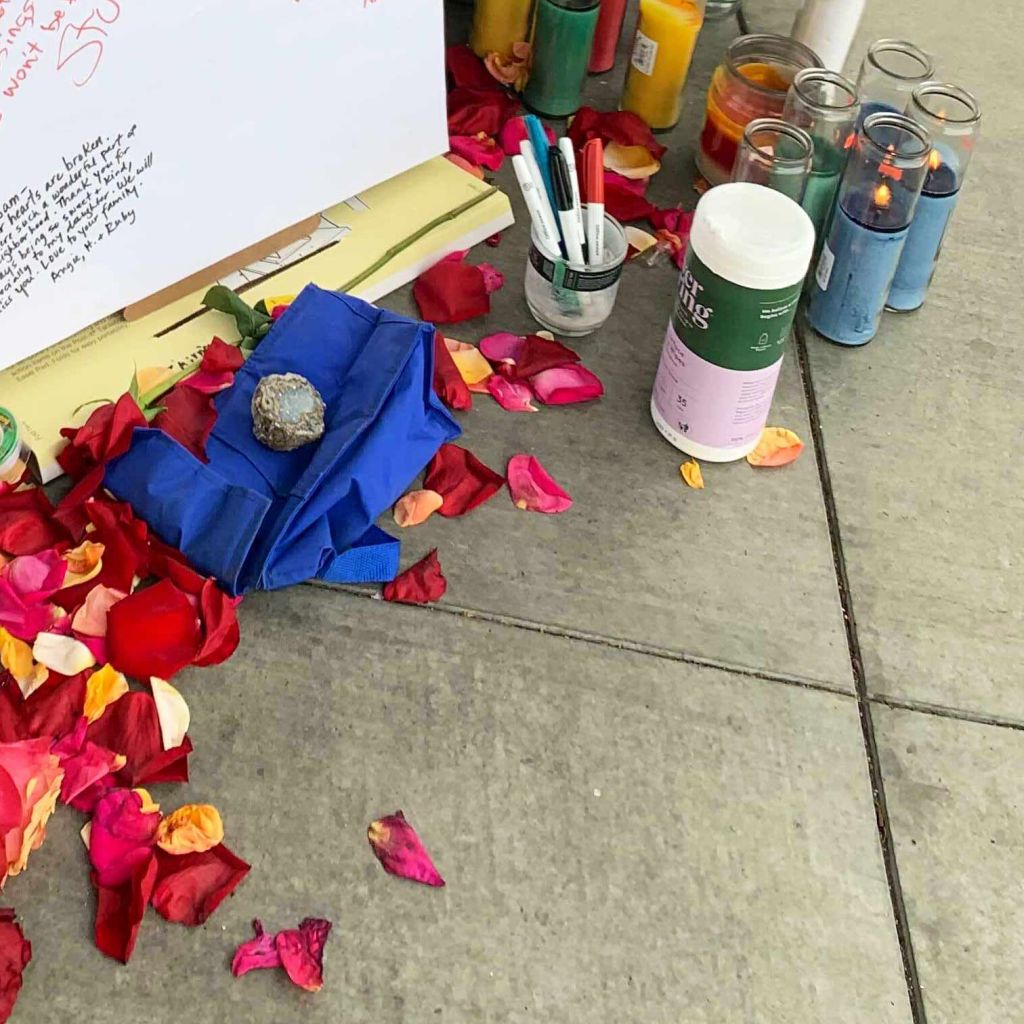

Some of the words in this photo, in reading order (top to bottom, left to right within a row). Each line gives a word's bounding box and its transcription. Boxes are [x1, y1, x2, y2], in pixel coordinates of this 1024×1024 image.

[7, 189, 42, 227] hearts
[44, 174, 64, 193] are
[15, 210, 41, 234] such
[51, 157, 97, 203] wonderful
[55, 178, 92, 211] Thank
[93, 161, 114, 184] you
[19, 232, 49, 260] being
[40, 246, 67, 272] Love
[77, 215, 100, 240] your
